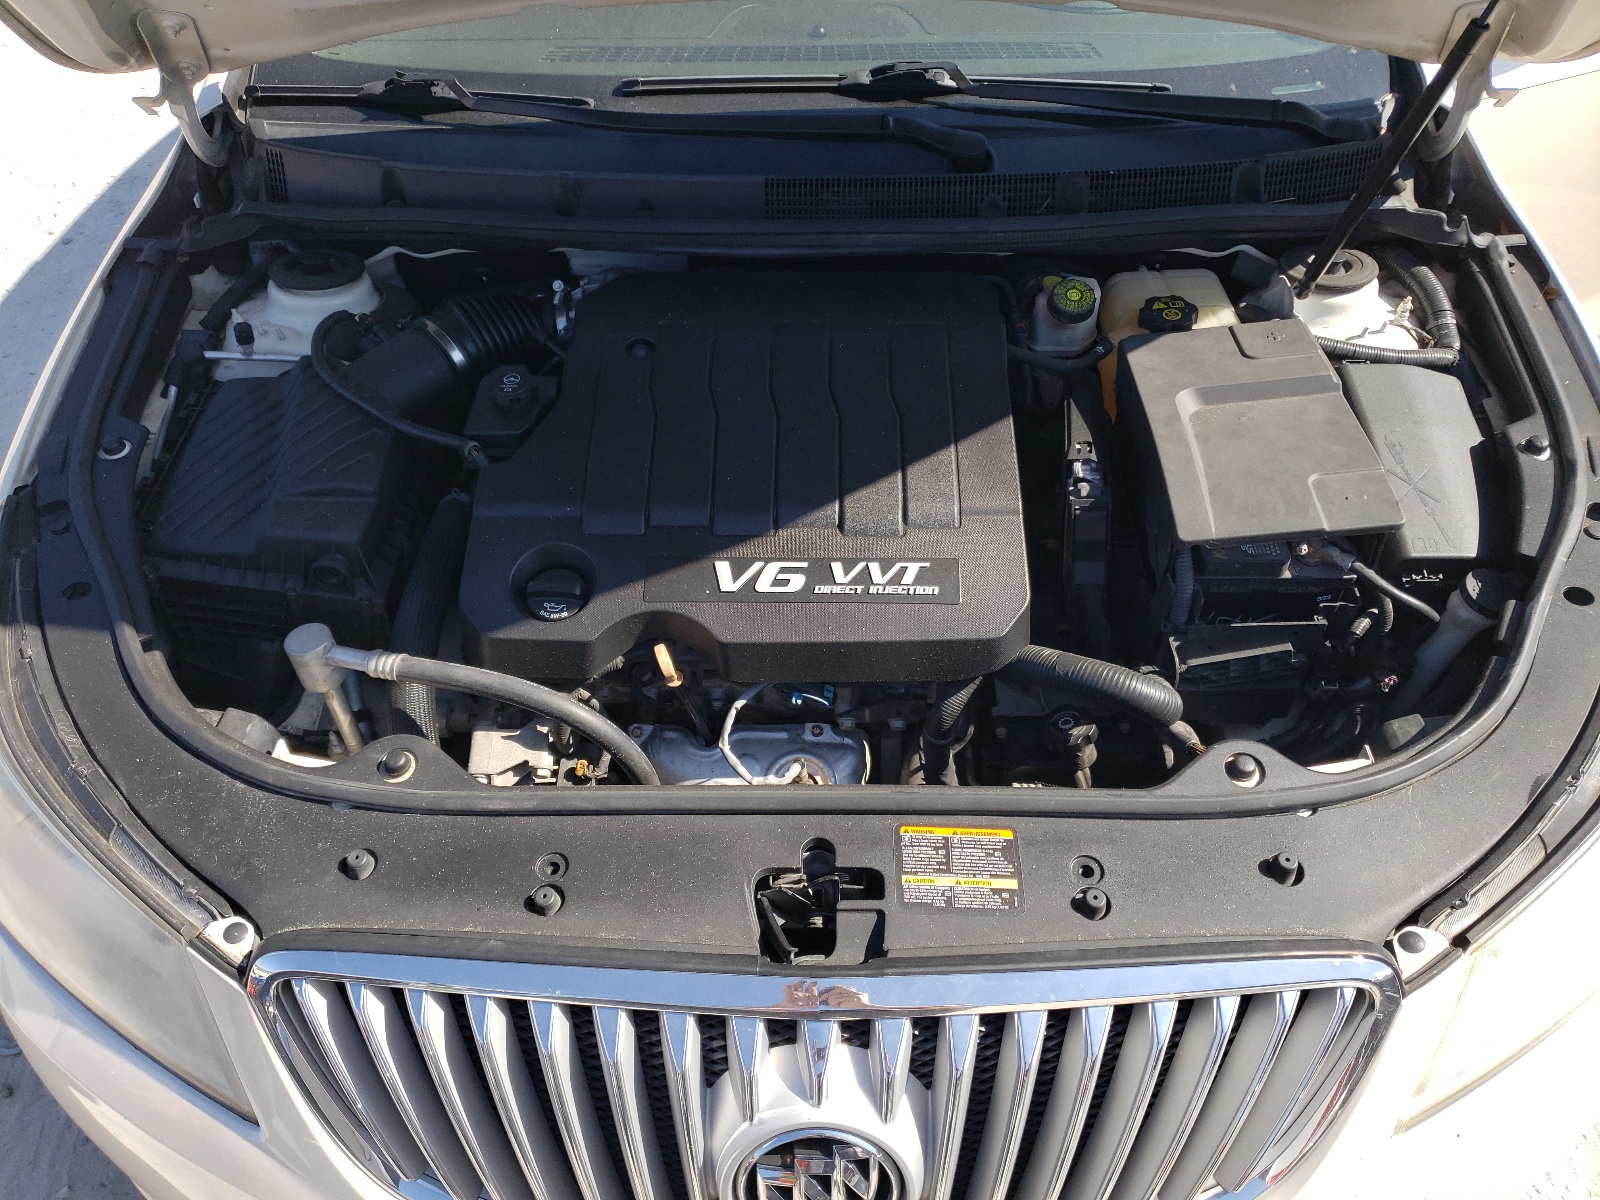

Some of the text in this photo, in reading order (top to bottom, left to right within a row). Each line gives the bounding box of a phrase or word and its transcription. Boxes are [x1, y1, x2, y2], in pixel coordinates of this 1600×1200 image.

[714, 561, 930, 593] V6 VVT
[813, 585, 939, 595] DIRECT INJECTION
